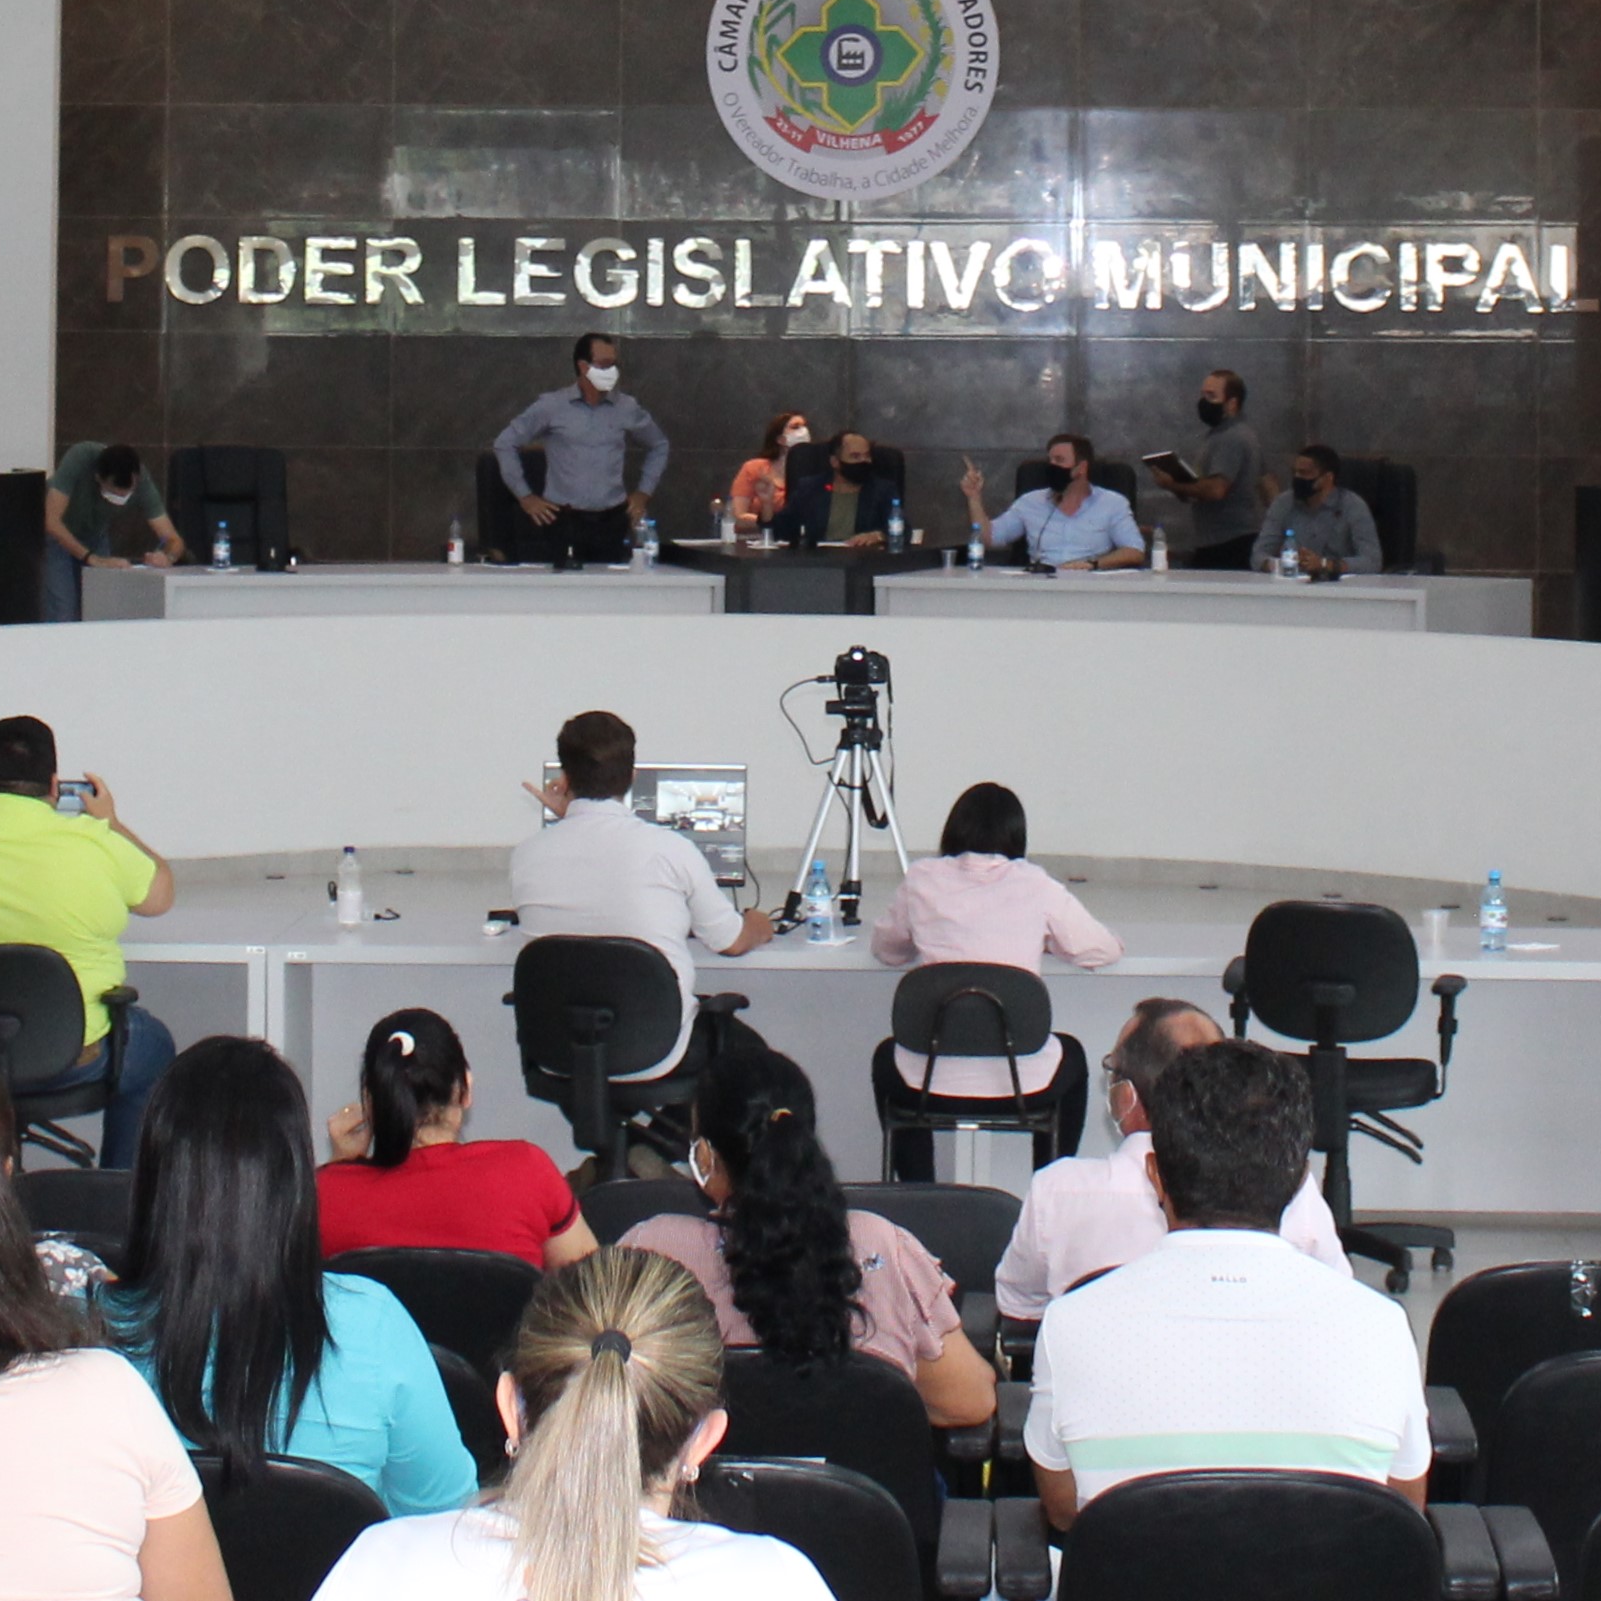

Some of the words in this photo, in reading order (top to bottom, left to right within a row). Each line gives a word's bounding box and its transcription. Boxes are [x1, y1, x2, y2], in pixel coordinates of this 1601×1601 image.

[723, 92, 739, 107] O
[731, 106, 784, 164] Vereador
[861, 176, 871, 189] a
[874, 157, 929, 187] Cidade
[816, 131, 883, 150] VILHENA
[106, 234, 424, 305] PODER
[458, 237, 1064, 312] LEGISLATIVO
[1093, 239, 1600, 313] MUNICIPAL
